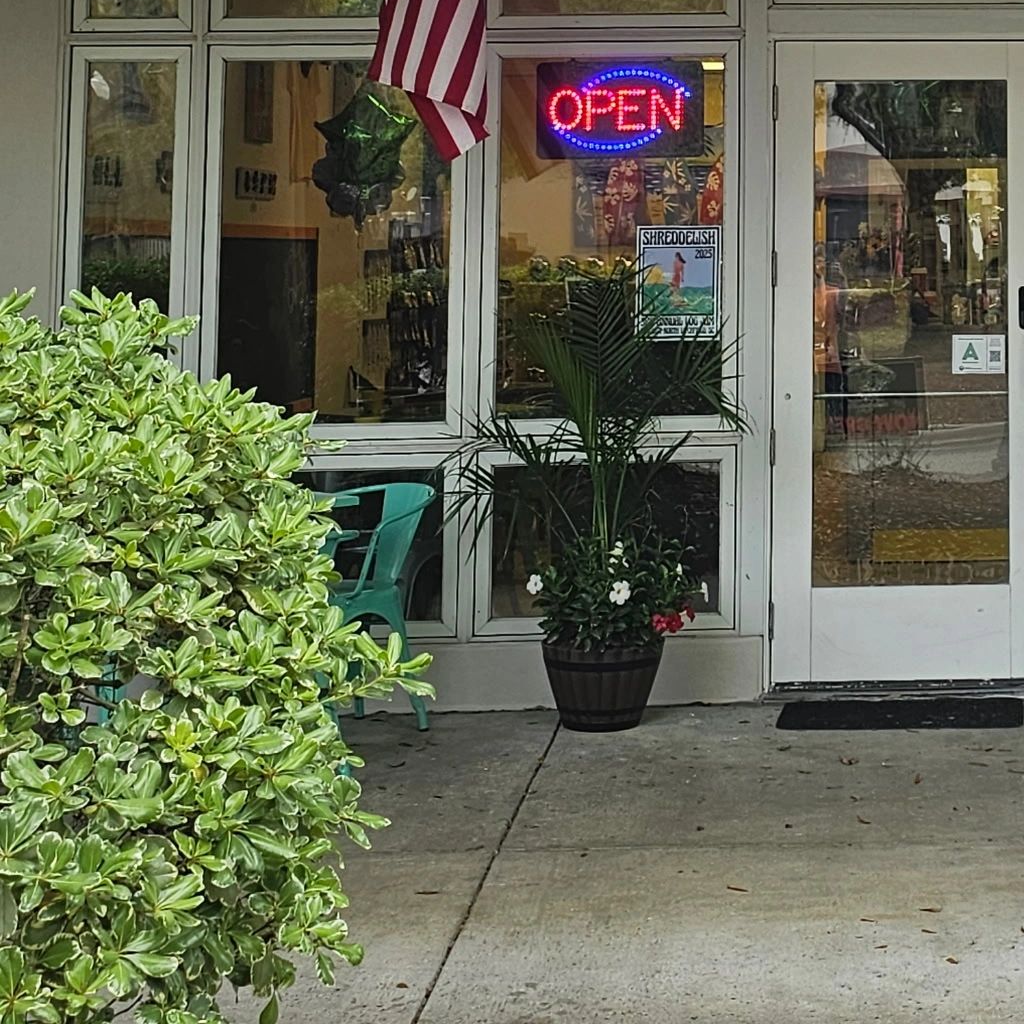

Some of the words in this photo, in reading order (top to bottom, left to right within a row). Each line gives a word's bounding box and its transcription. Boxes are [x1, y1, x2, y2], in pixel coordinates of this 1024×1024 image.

[548, 87, 684, 132] OPEN
[642, 230, 716, 246] SHREDDELISH
[694, 248, 713, 259] 2025
[962, 342, 979, 361] A
